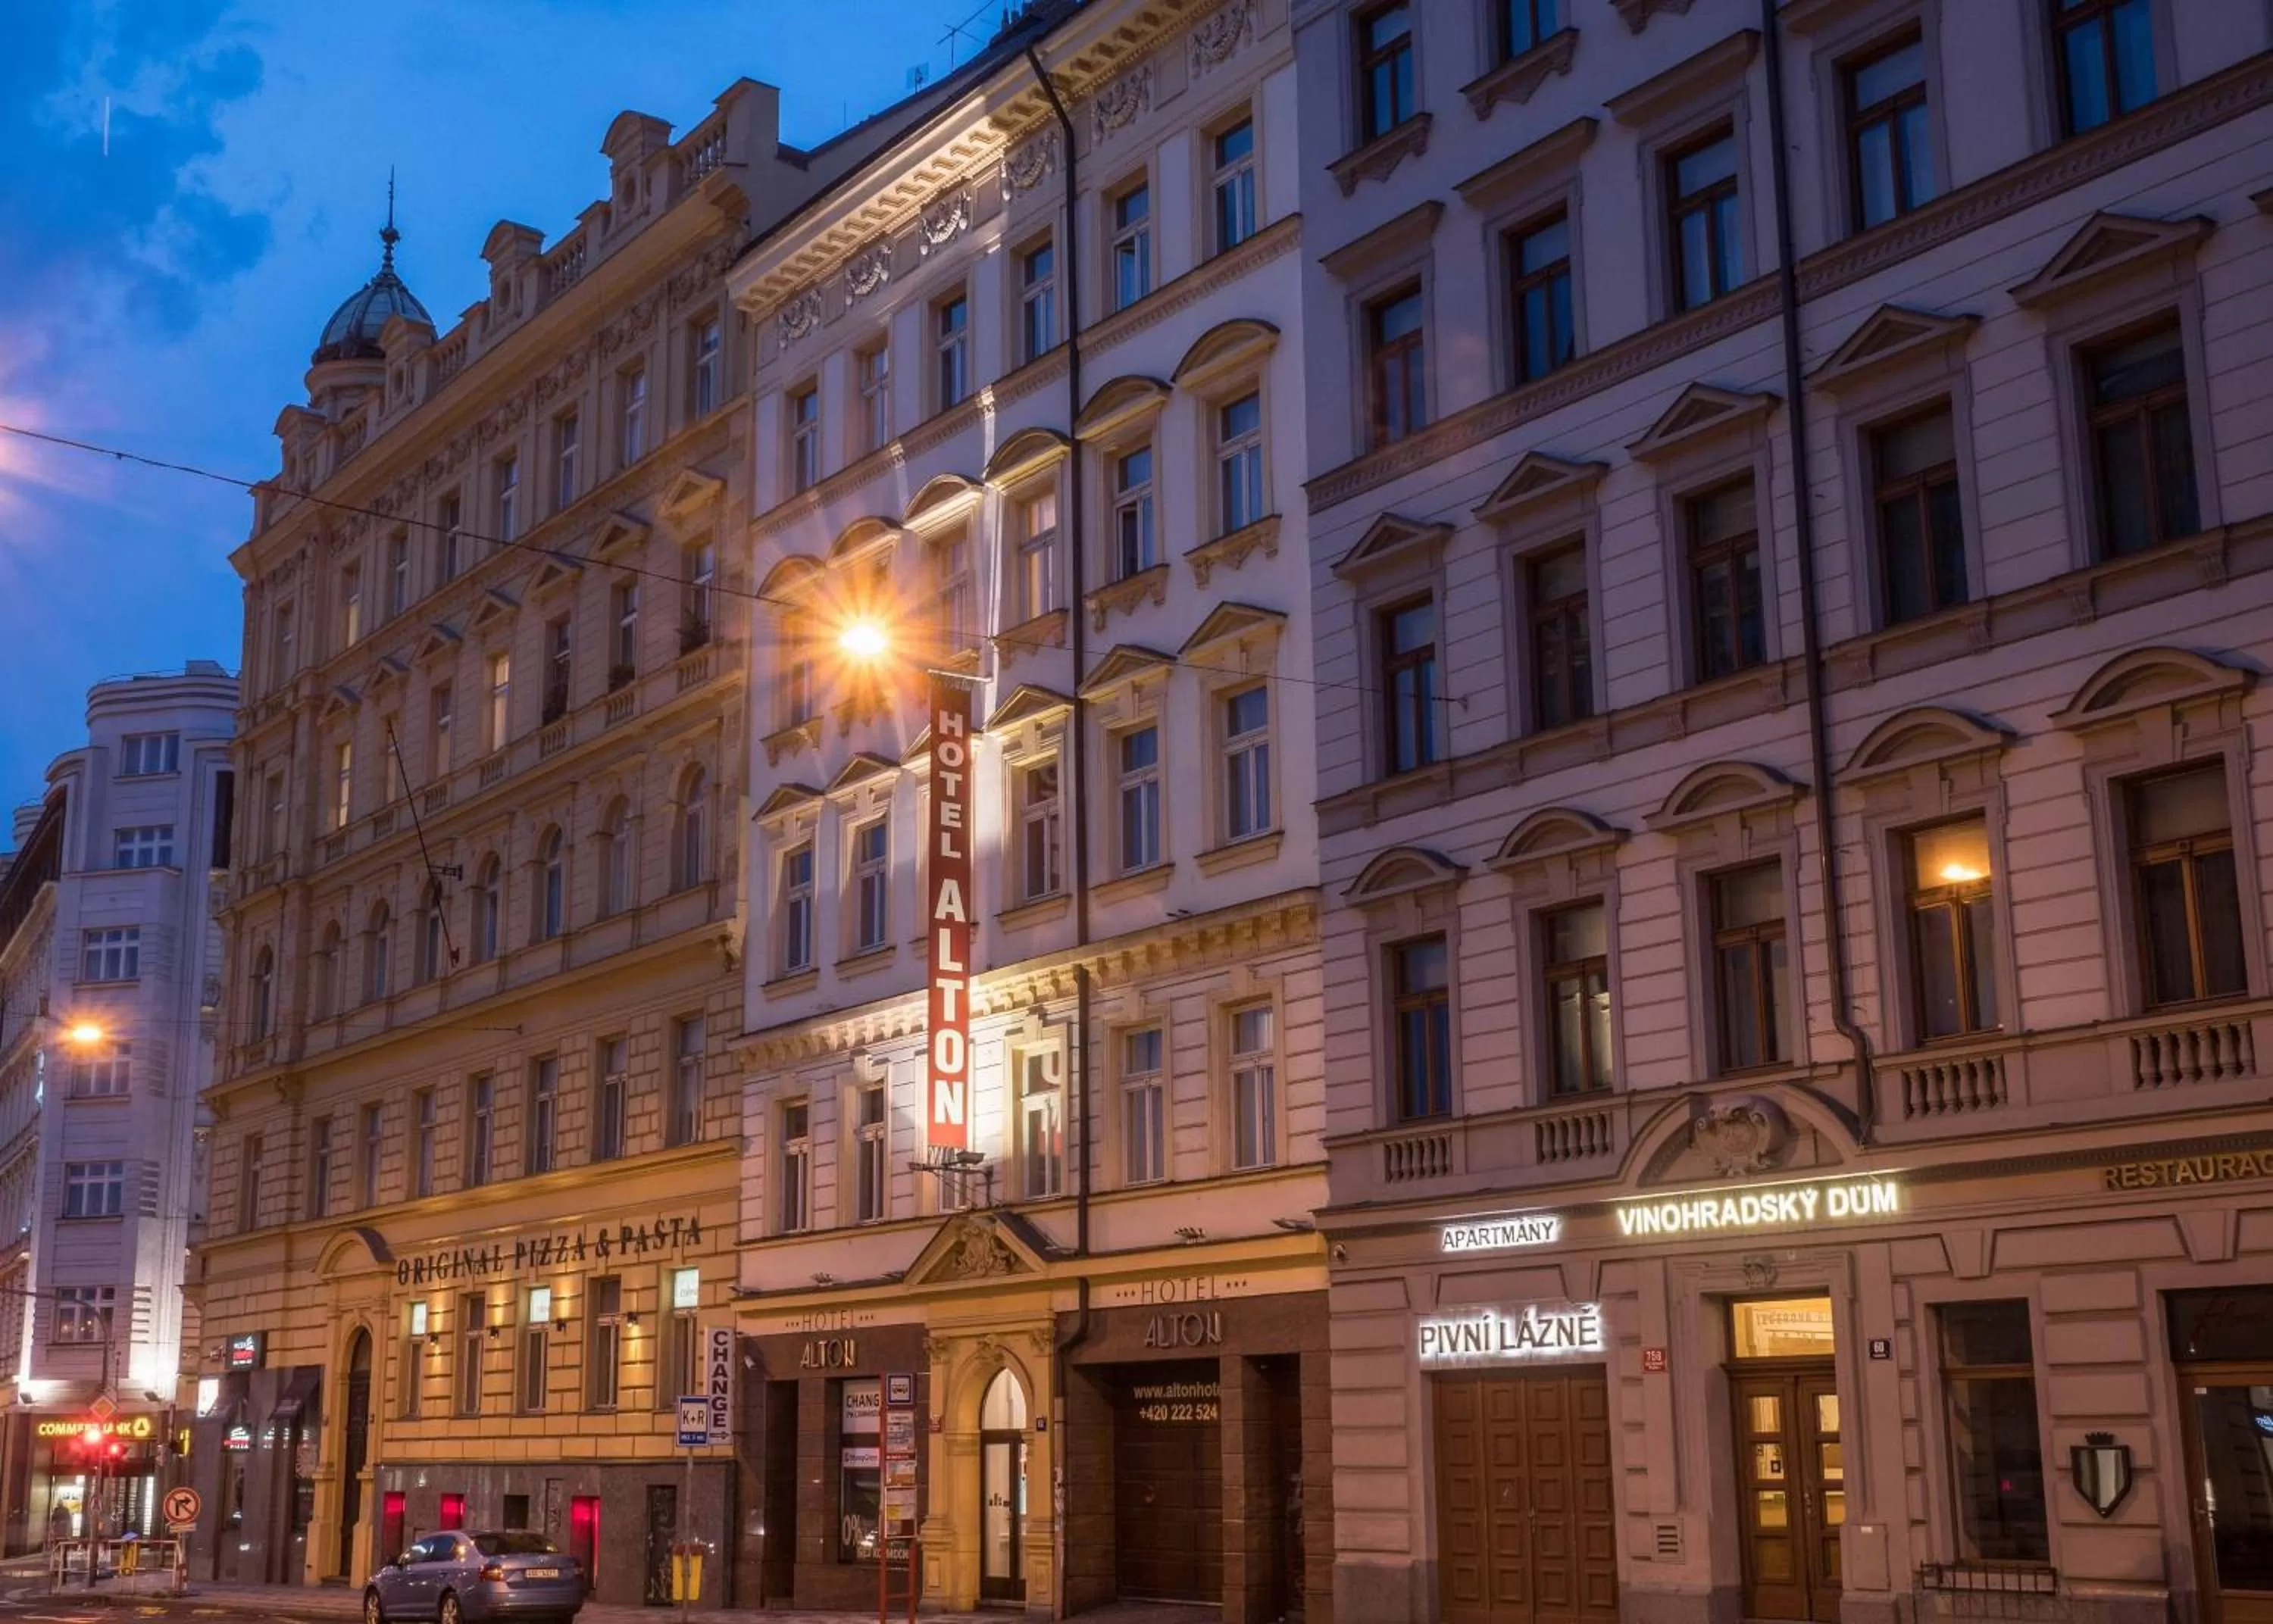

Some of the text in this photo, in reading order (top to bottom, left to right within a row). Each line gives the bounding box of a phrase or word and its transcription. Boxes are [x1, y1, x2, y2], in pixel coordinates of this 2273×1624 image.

[933, 710, 965, 1126] HOTEL ALTON
[1617, 1188, 1818, 1235] VINOHRADSKÝ
[1443, 1219, 1555, 1250] APARTMÁNY
[398, 1215, 702, 1286] ORIGINAL PIZZA & PASTA
[1142, 1276, 1221, 1302] HOTEL
[802, 1308, 855, 1331] HOTEL
[1144, 1310, 1223, 1348] ALTON
[1420, 1307, 1598, 1354] PIVNÍ LÁZNĚ
[800, 1338, 858, 1369] ALTON
[711, 1331, 730, 1429] CHANGE
[846, 1393, 880, 1408] CHANG
[1139, 1402, 1218, 1421] +420 222 524
[683, 1410, 705, 1425] K+R
